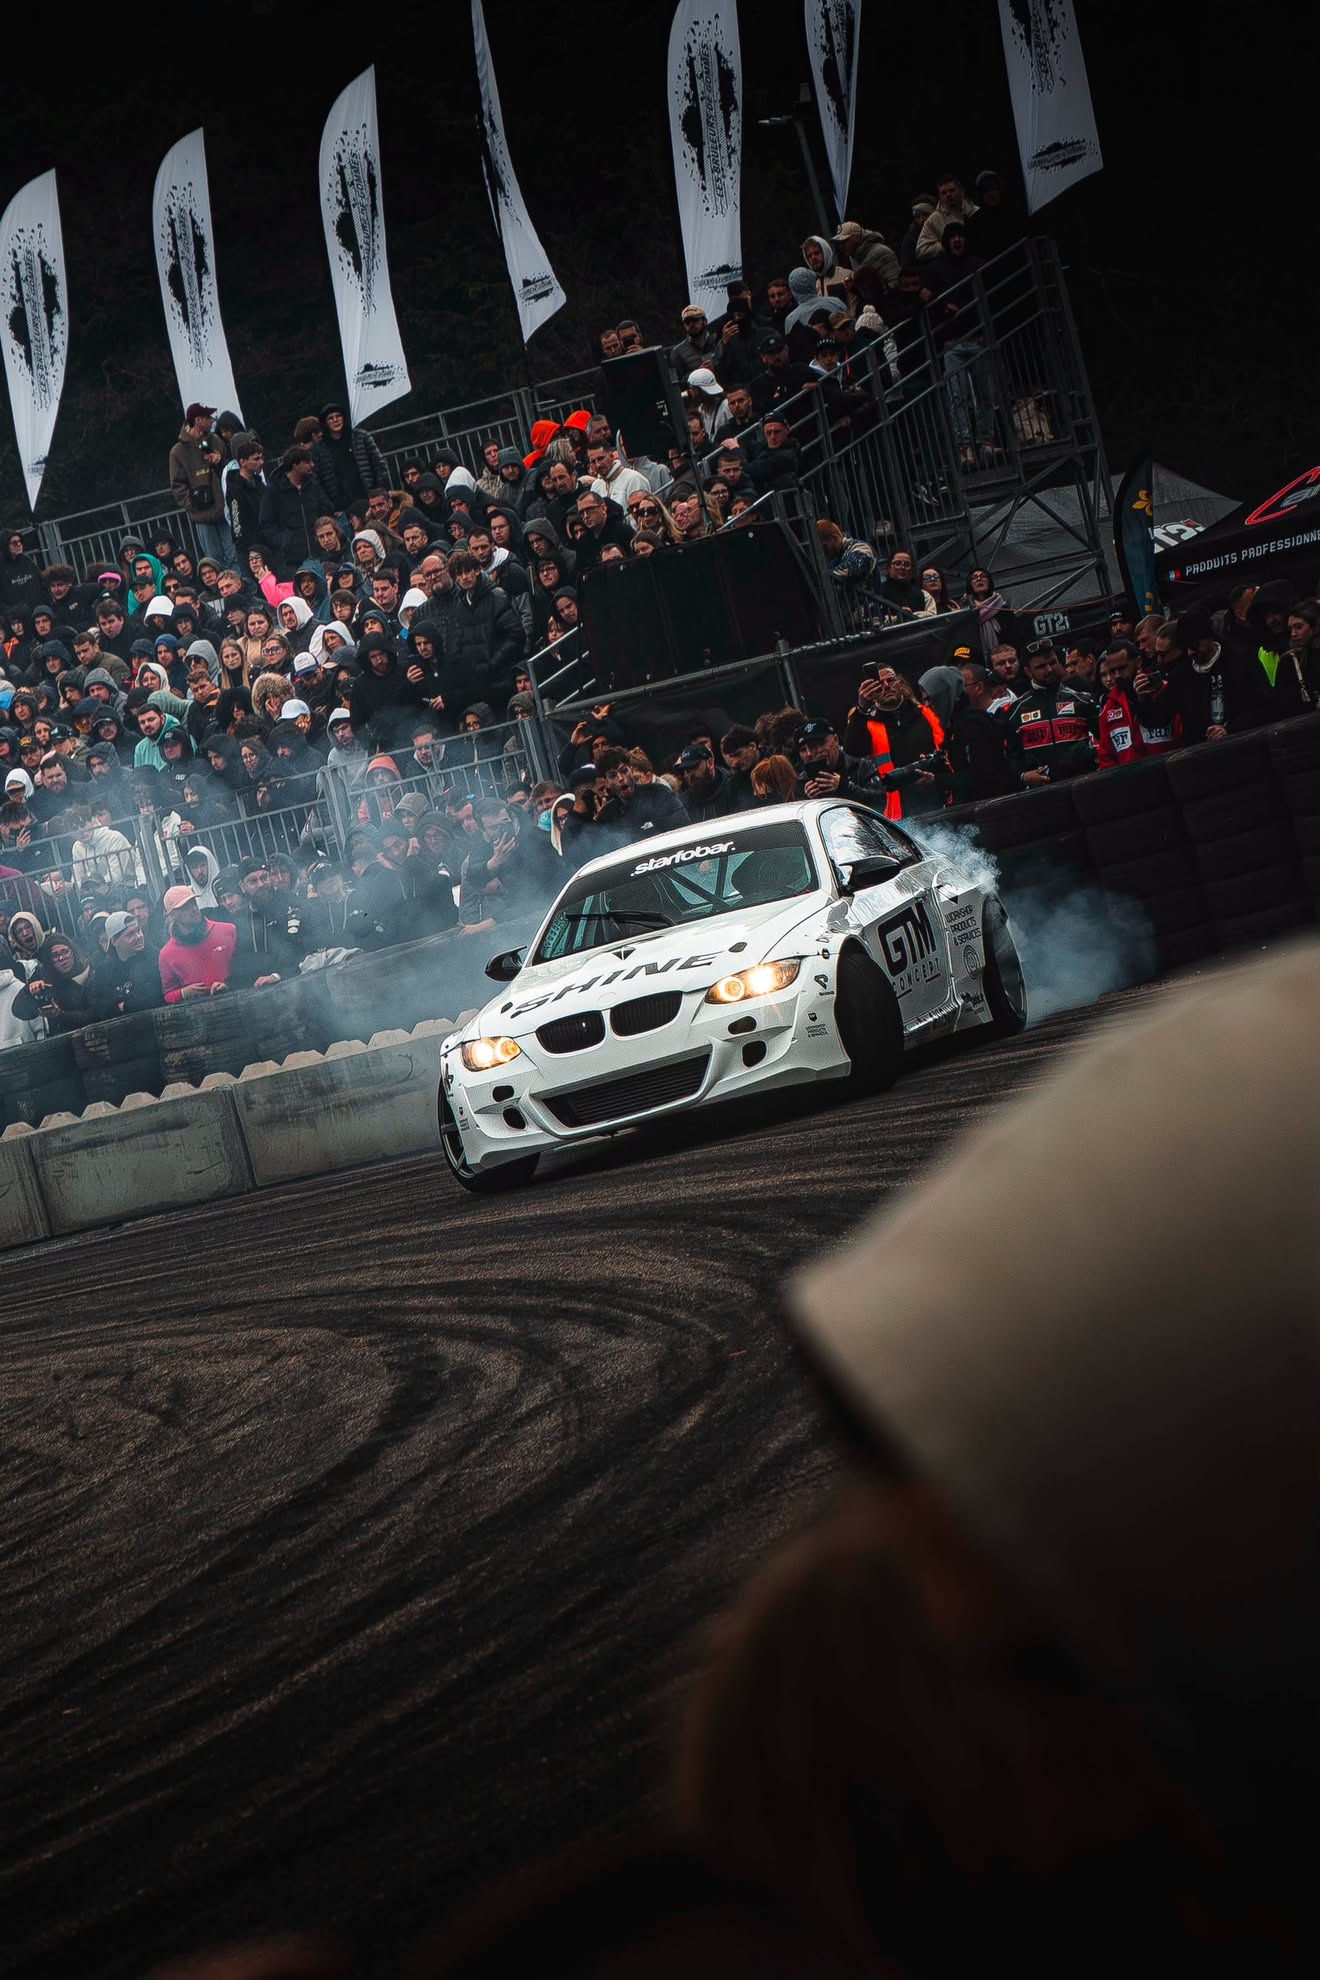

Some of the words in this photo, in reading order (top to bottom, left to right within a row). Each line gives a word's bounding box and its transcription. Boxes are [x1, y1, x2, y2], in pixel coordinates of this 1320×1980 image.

[701, 41, 713, 95] GOMMES
[350, 152, 365, 201] GOMMES
[1185, 552, 1238, 577] PRODUITS
[944, 904, 974, 923] WORKSHOP
[950, 916, 977, 935] PRODUCTS
[878, 902, 937, 977] GTM
[957, 927, 982, 945] SERVICES
[510, 950, 726, 1019] SHINE
